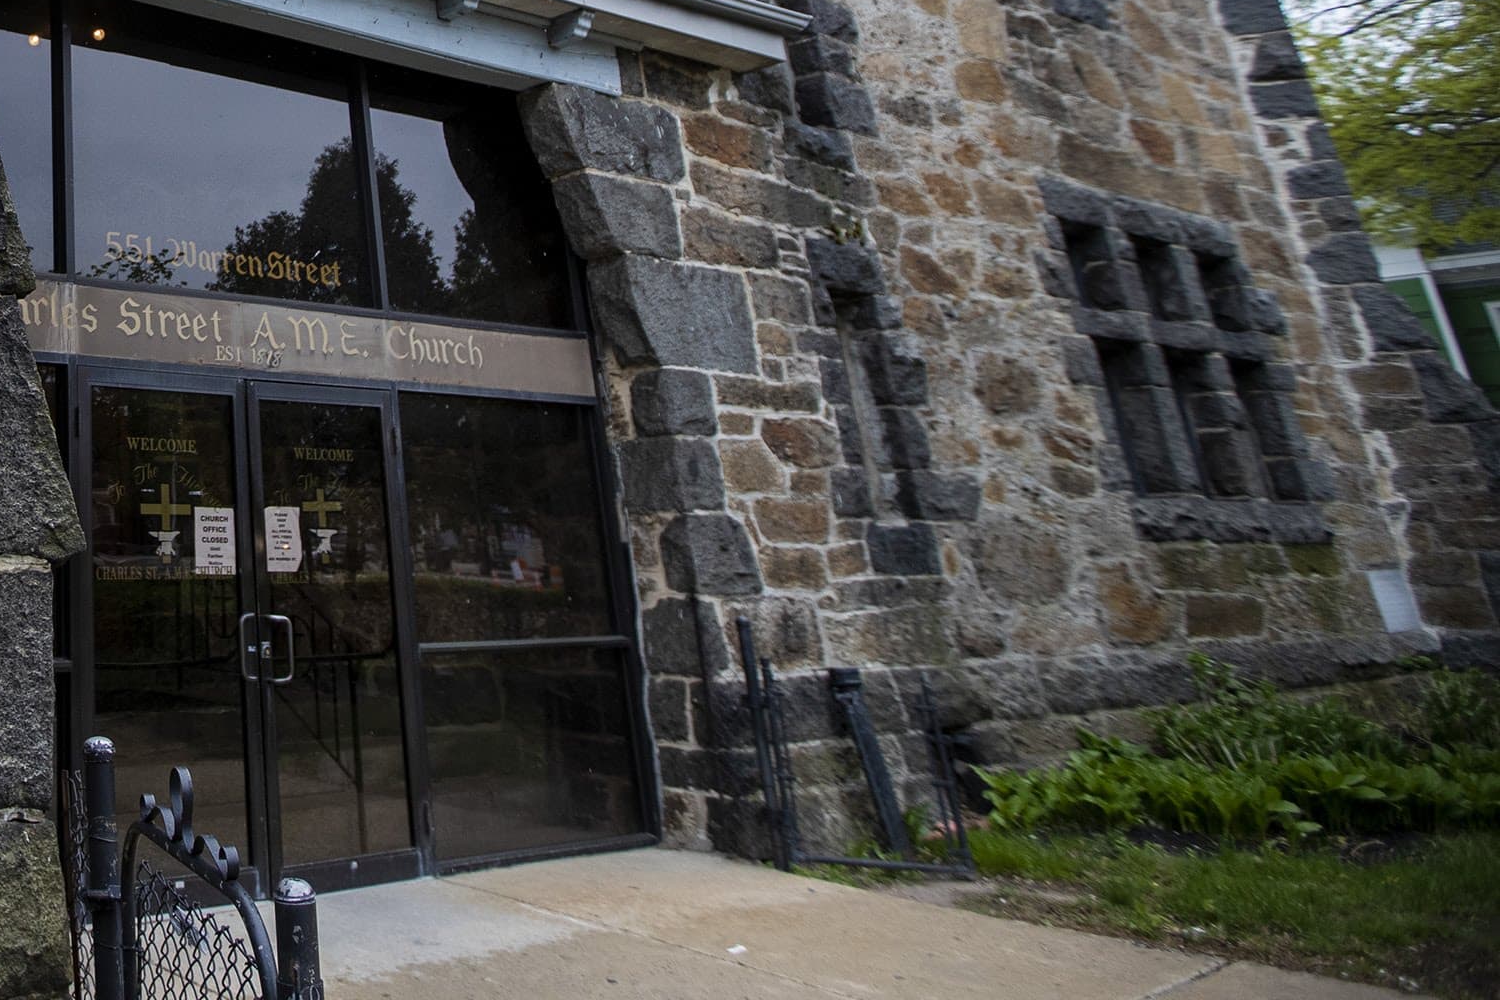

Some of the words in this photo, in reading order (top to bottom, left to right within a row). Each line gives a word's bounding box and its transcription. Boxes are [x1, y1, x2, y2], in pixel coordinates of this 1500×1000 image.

[104, 231, 155, 264] 551
[116, 297, 222, 342] Street
[386, 325, 483, 369] Church
[126, 437, 197, 453] WELCOME
[294, 447, 354, 462] WELCOME
[200, 515, 229, 523] CHURCH
[203, 526, 227, 534] OFFICE
[202, 536, 229, 544] CLOSED
[96, 565, 142, 581] CHARLES
